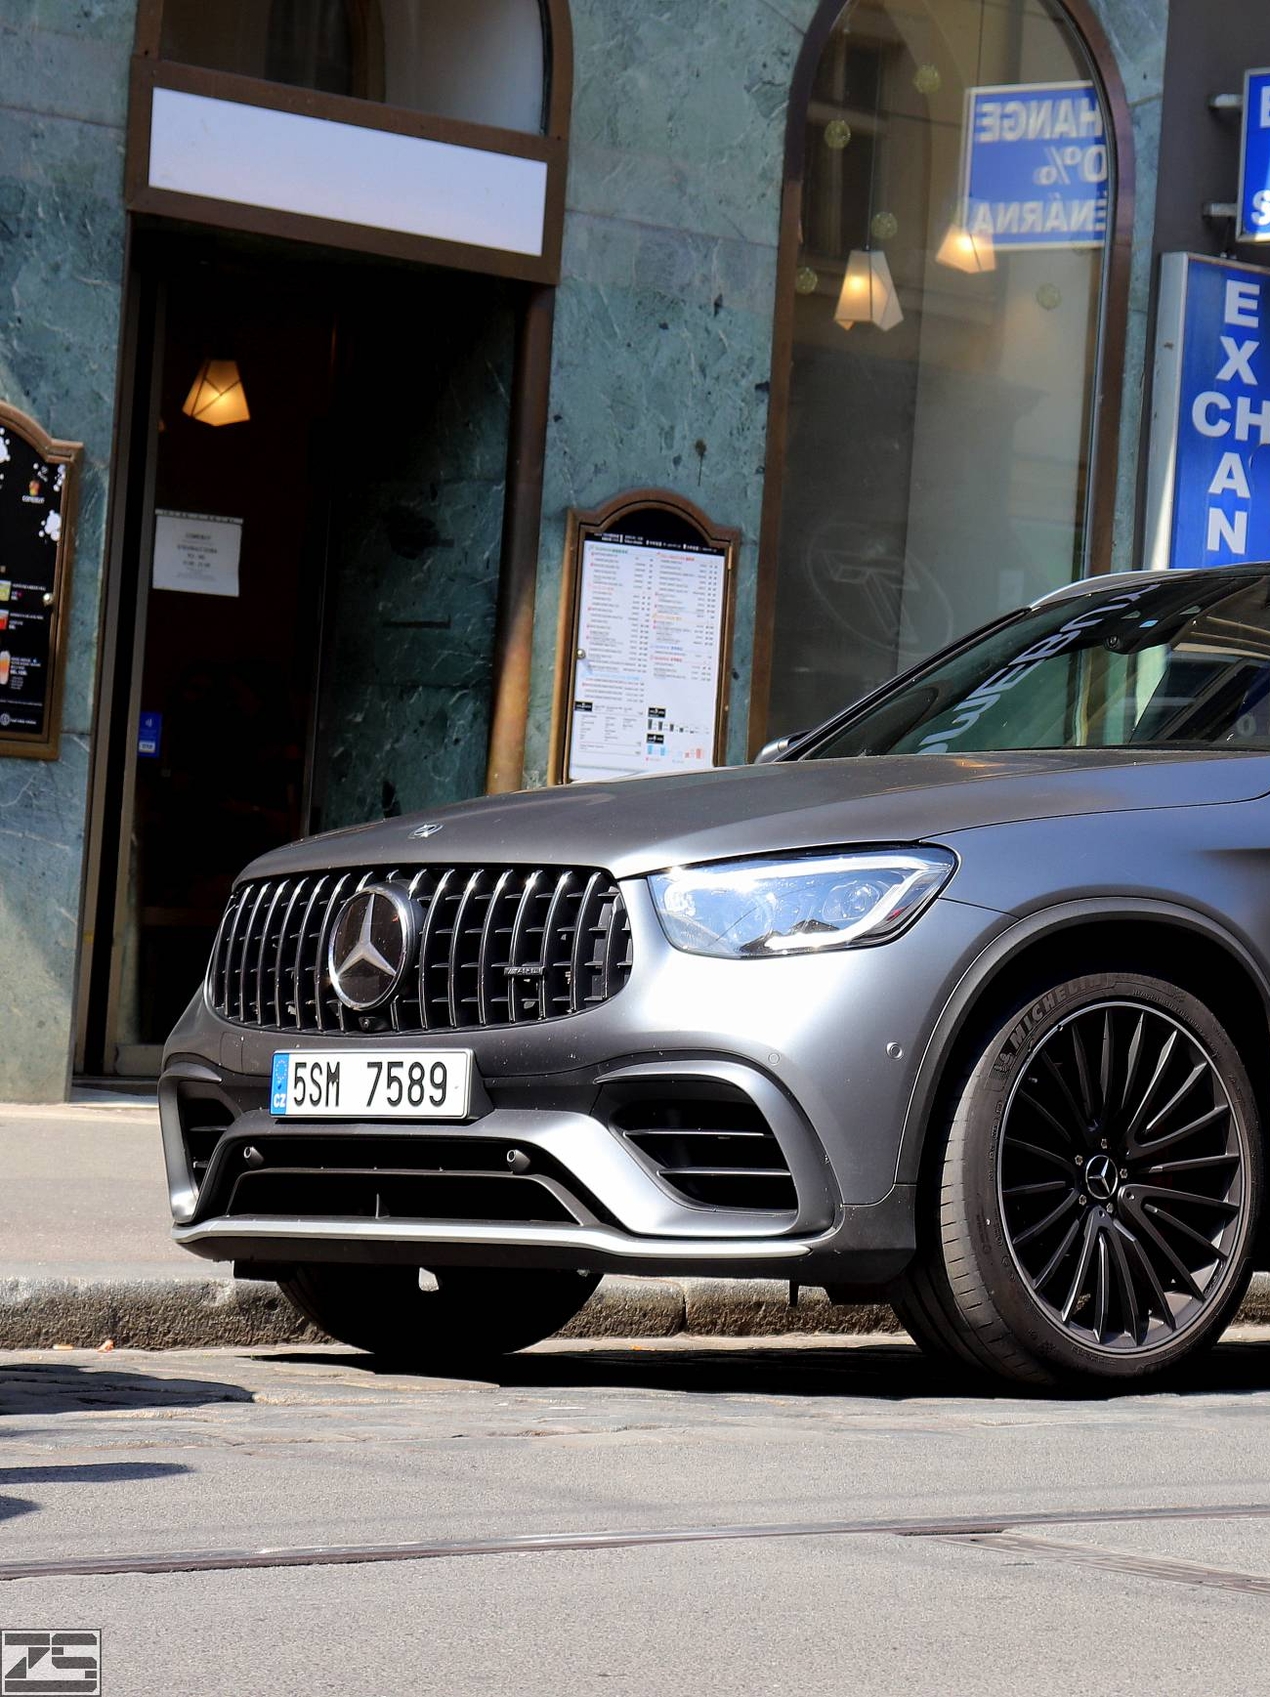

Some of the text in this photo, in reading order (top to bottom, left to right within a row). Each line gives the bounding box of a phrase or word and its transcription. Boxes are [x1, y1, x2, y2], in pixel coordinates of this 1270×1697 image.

[293, 1061, 447, 1107] 5SM 7589
[273, 1093, 286, 1109] CZ
